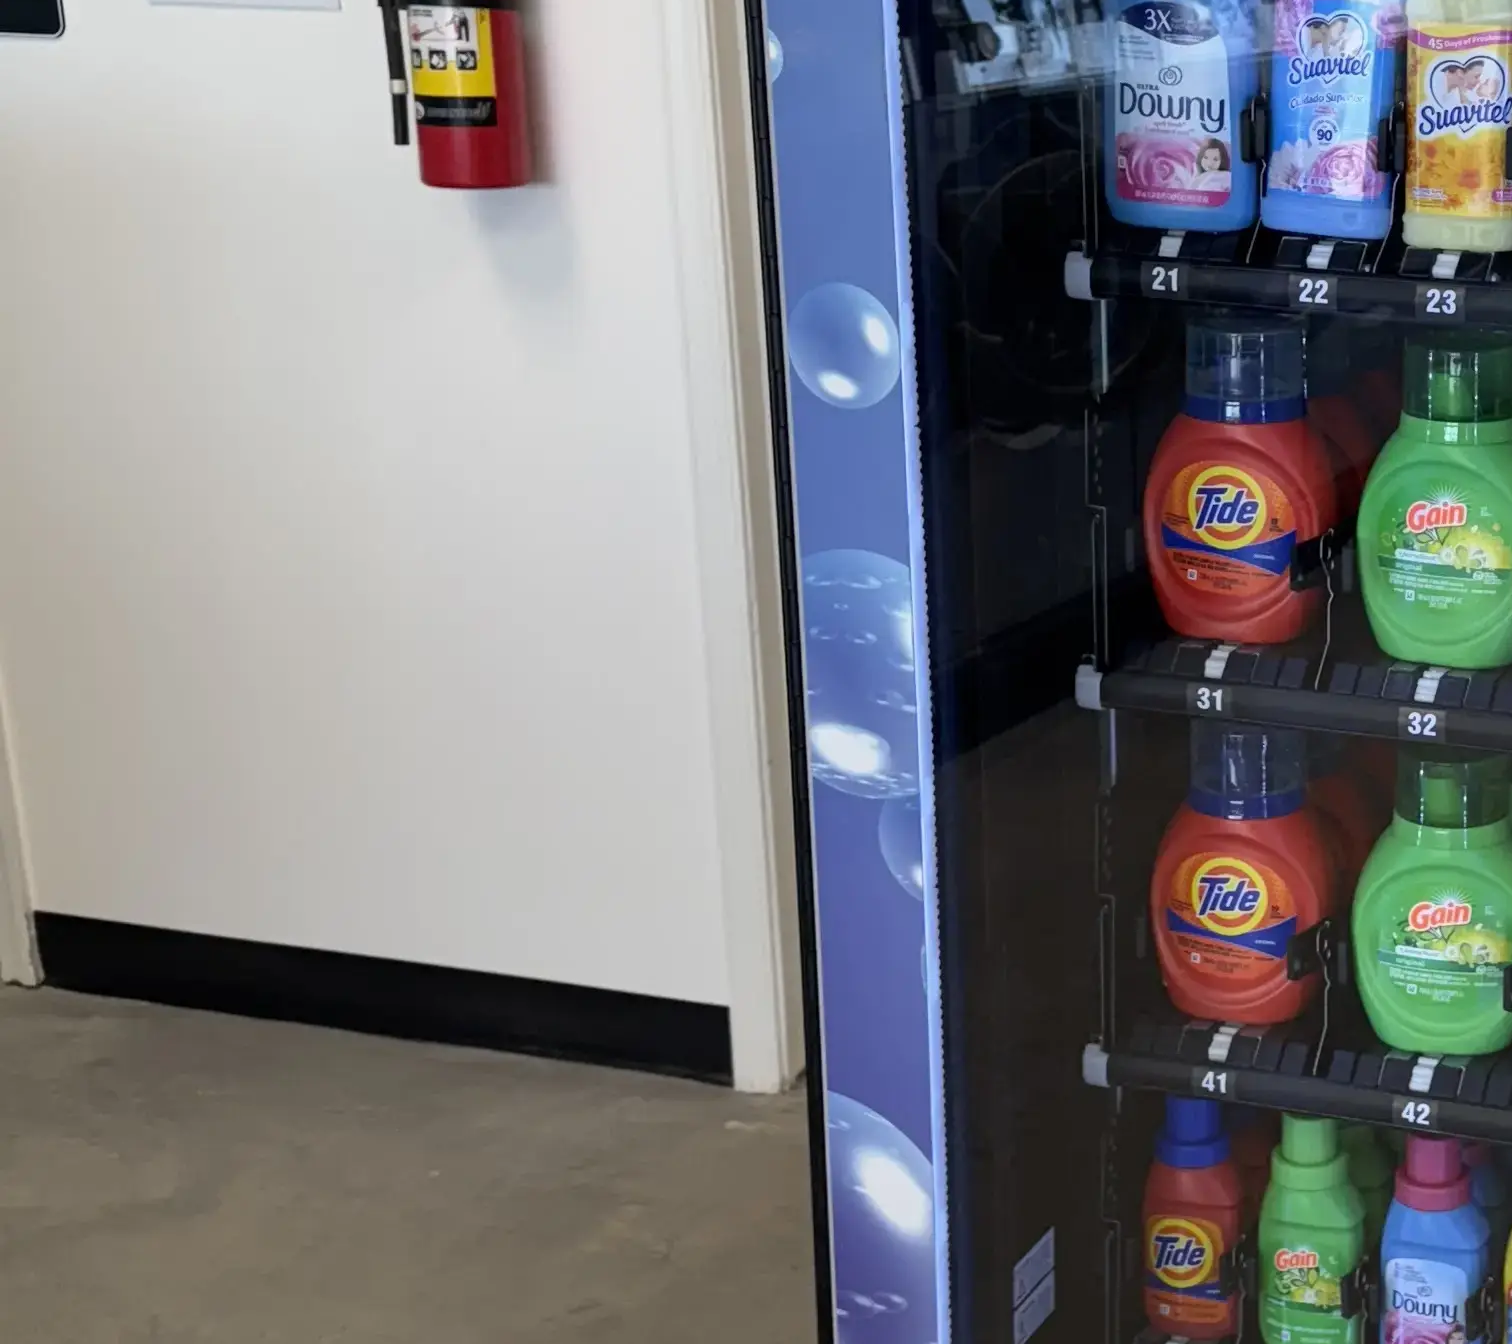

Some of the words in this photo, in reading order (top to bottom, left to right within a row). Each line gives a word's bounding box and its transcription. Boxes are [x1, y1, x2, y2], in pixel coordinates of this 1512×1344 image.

[1144, 8, 1172, 32] 3X
[1428, 38, 1443, 49] 45
[1289, 55, 1369, 85] Suavitel
[1120, 82, 1225, 133] Downy
[1419, 97, 1512, 135] Suavitel
[1317, 129, 1332, 141] 90
[1152, 267, 1179, 292] 21
[1299, 279, 1328, 304] 22
[1426, 289, 1457, 314] 23
[1195, 487, 1259, 529] Tide
[1408, 502, 1465, 532] Gain
[1196, 687, 1223, 711] 31
[1407, 712, 1437, 737] 32
[1197, 876, 1261, 916] Tide
[1410, 903, 1470, 930] Gain
[1201, 1071, 1227, 1093] 41
[1402, 1102, 1430, 1125] 42
[1154, 1236, 1206, 1269] Tide
[1275, 1250, 1318, 1269] Gain
[1392, 1290, 1458, 1324] Downy
